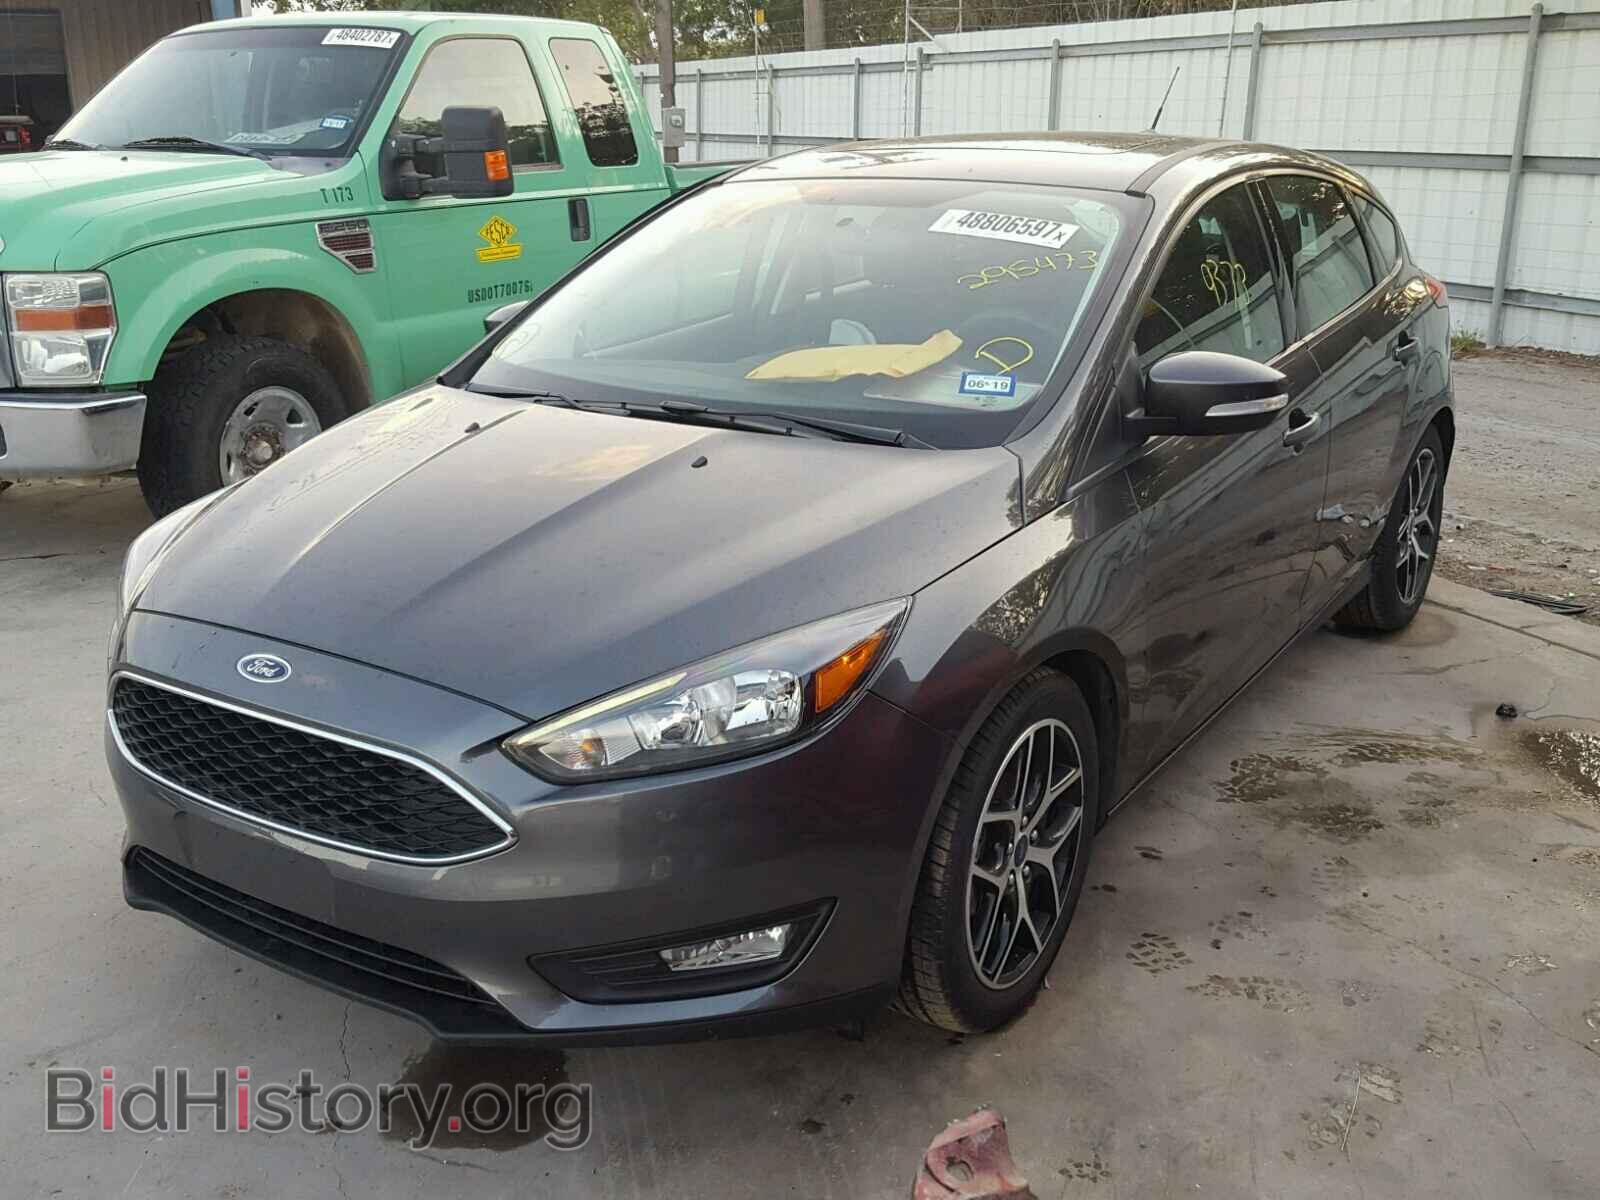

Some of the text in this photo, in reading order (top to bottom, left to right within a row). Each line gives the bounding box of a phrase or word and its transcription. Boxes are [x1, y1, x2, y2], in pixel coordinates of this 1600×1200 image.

[320, 187, 354, 203] T 173
[246, 659, 280, 677] Ford
